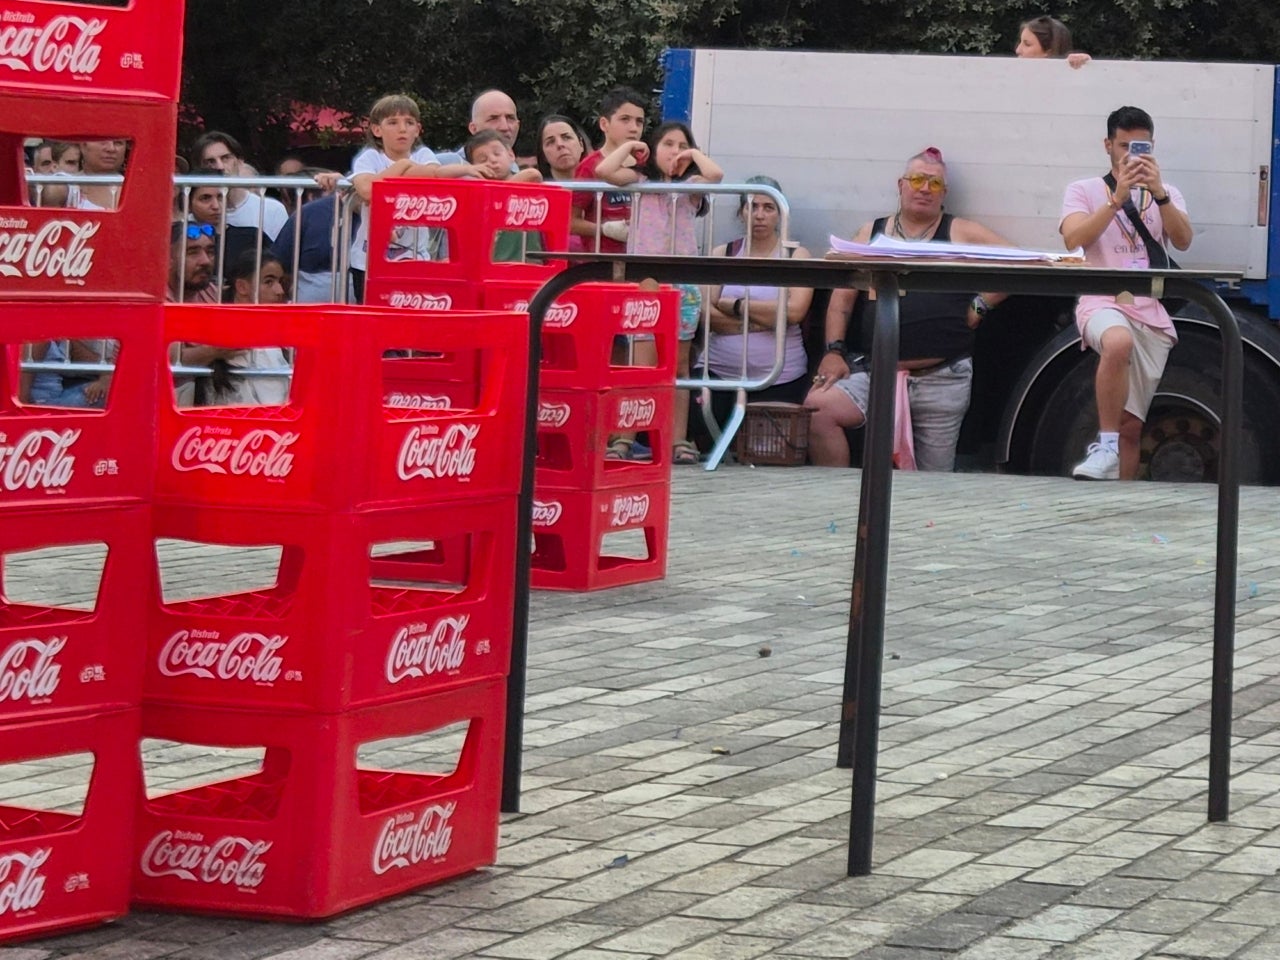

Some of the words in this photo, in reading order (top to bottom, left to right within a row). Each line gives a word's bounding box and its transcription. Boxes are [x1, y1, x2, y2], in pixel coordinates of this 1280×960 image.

[0, 16, 107, 73] ca-Cola
[393, 194, 457, 221] Coca-Cola
[172, 427, 299, 476] Coca-Cola
[398, 424, 480, 480] Coca-Cola
[159, 630, 288, 681] Coca-Cola
[386, 615, 469, 683] Coca-Cola
[142, 831, 272, 887] Coca-Cola
[373, 802, 456, 874] Coca-Cola
